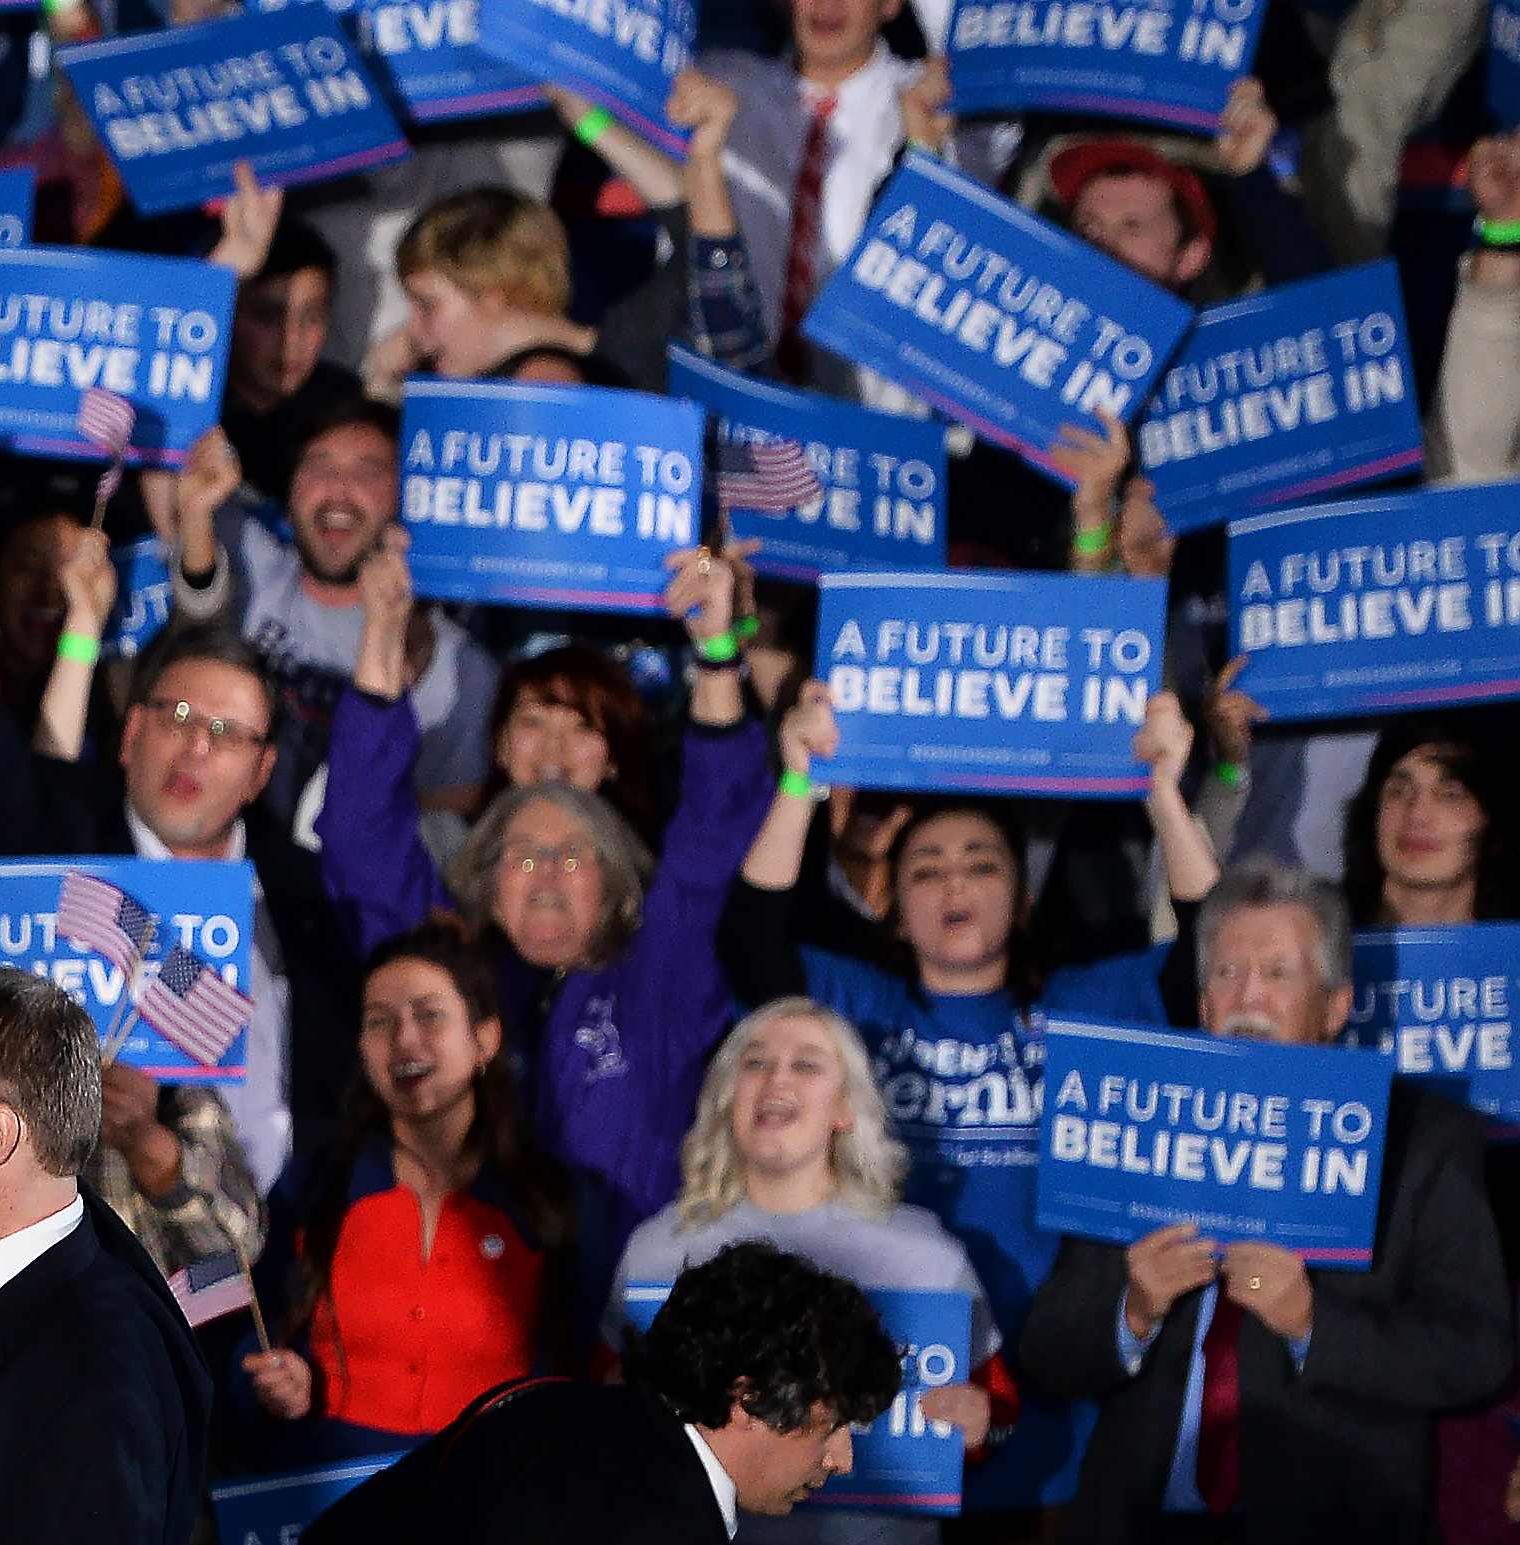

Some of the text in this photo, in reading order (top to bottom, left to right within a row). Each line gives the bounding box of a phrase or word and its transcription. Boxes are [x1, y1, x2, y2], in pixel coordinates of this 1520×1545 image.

[955, 4, 1247, 70] BELIEVE IN
[94, 36, 348, 115] A FUTURE TO
[106, 70, 372, 160] BELIEVE IN
[878, 201, 1154, 381] A FUTURE TO
[150, 304, 219, 355] TO
[852, 240, 1134, 418] BELIEVE IN
[1165, 311, 1398, 408] FUTURE TO
[149, 349, 215, 405] IN
[1139, 357, 1405, 468] BELIEVE IN
[406, 429, 695, 494] A FUTURE TO
[867, 449, 936, 500] TO
[402, 477, 695, 546] BELIEVE IN
[873, 497, 936, 545] IN
[1242, 537, 1467, 600] A FUTURE
[832, 619, 1152, 675] A FUTURE TO
[1238, 582, 1471, 652] BELIEVE
[827, 664, 1150, 726] BELIEVE IN
[171, 914, 240, 958] TO
[1056, 1068, 1372, 1147] A FUTURE TO
[1049, 1114, 1370, 1198] BELIEVE IN
